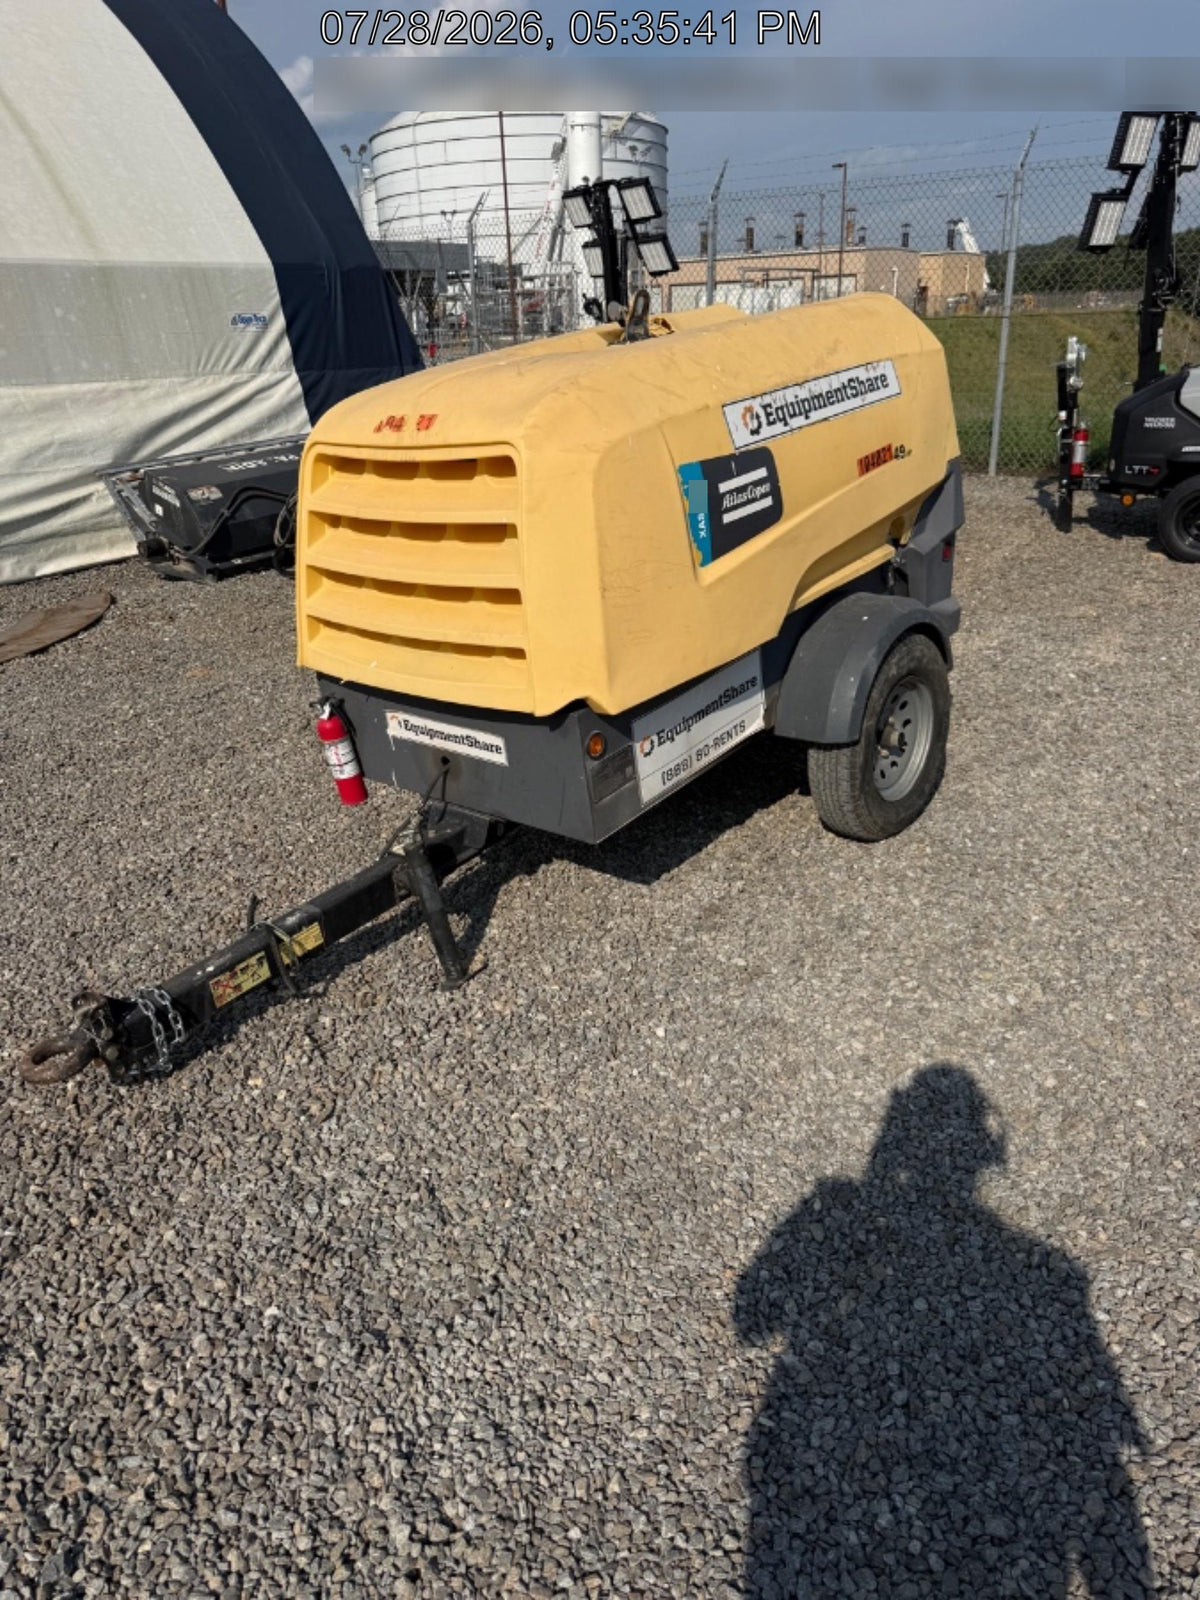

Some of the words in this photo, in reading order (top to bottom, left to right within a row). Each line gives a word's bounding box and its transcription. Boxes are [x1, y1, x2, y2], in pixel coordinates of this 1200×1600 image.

[761, 373, 889, 427] EquipmentShare
[402, 719, 503, 755] EquipmentShare
[656, 676, 758, 747] EquipmentShare
